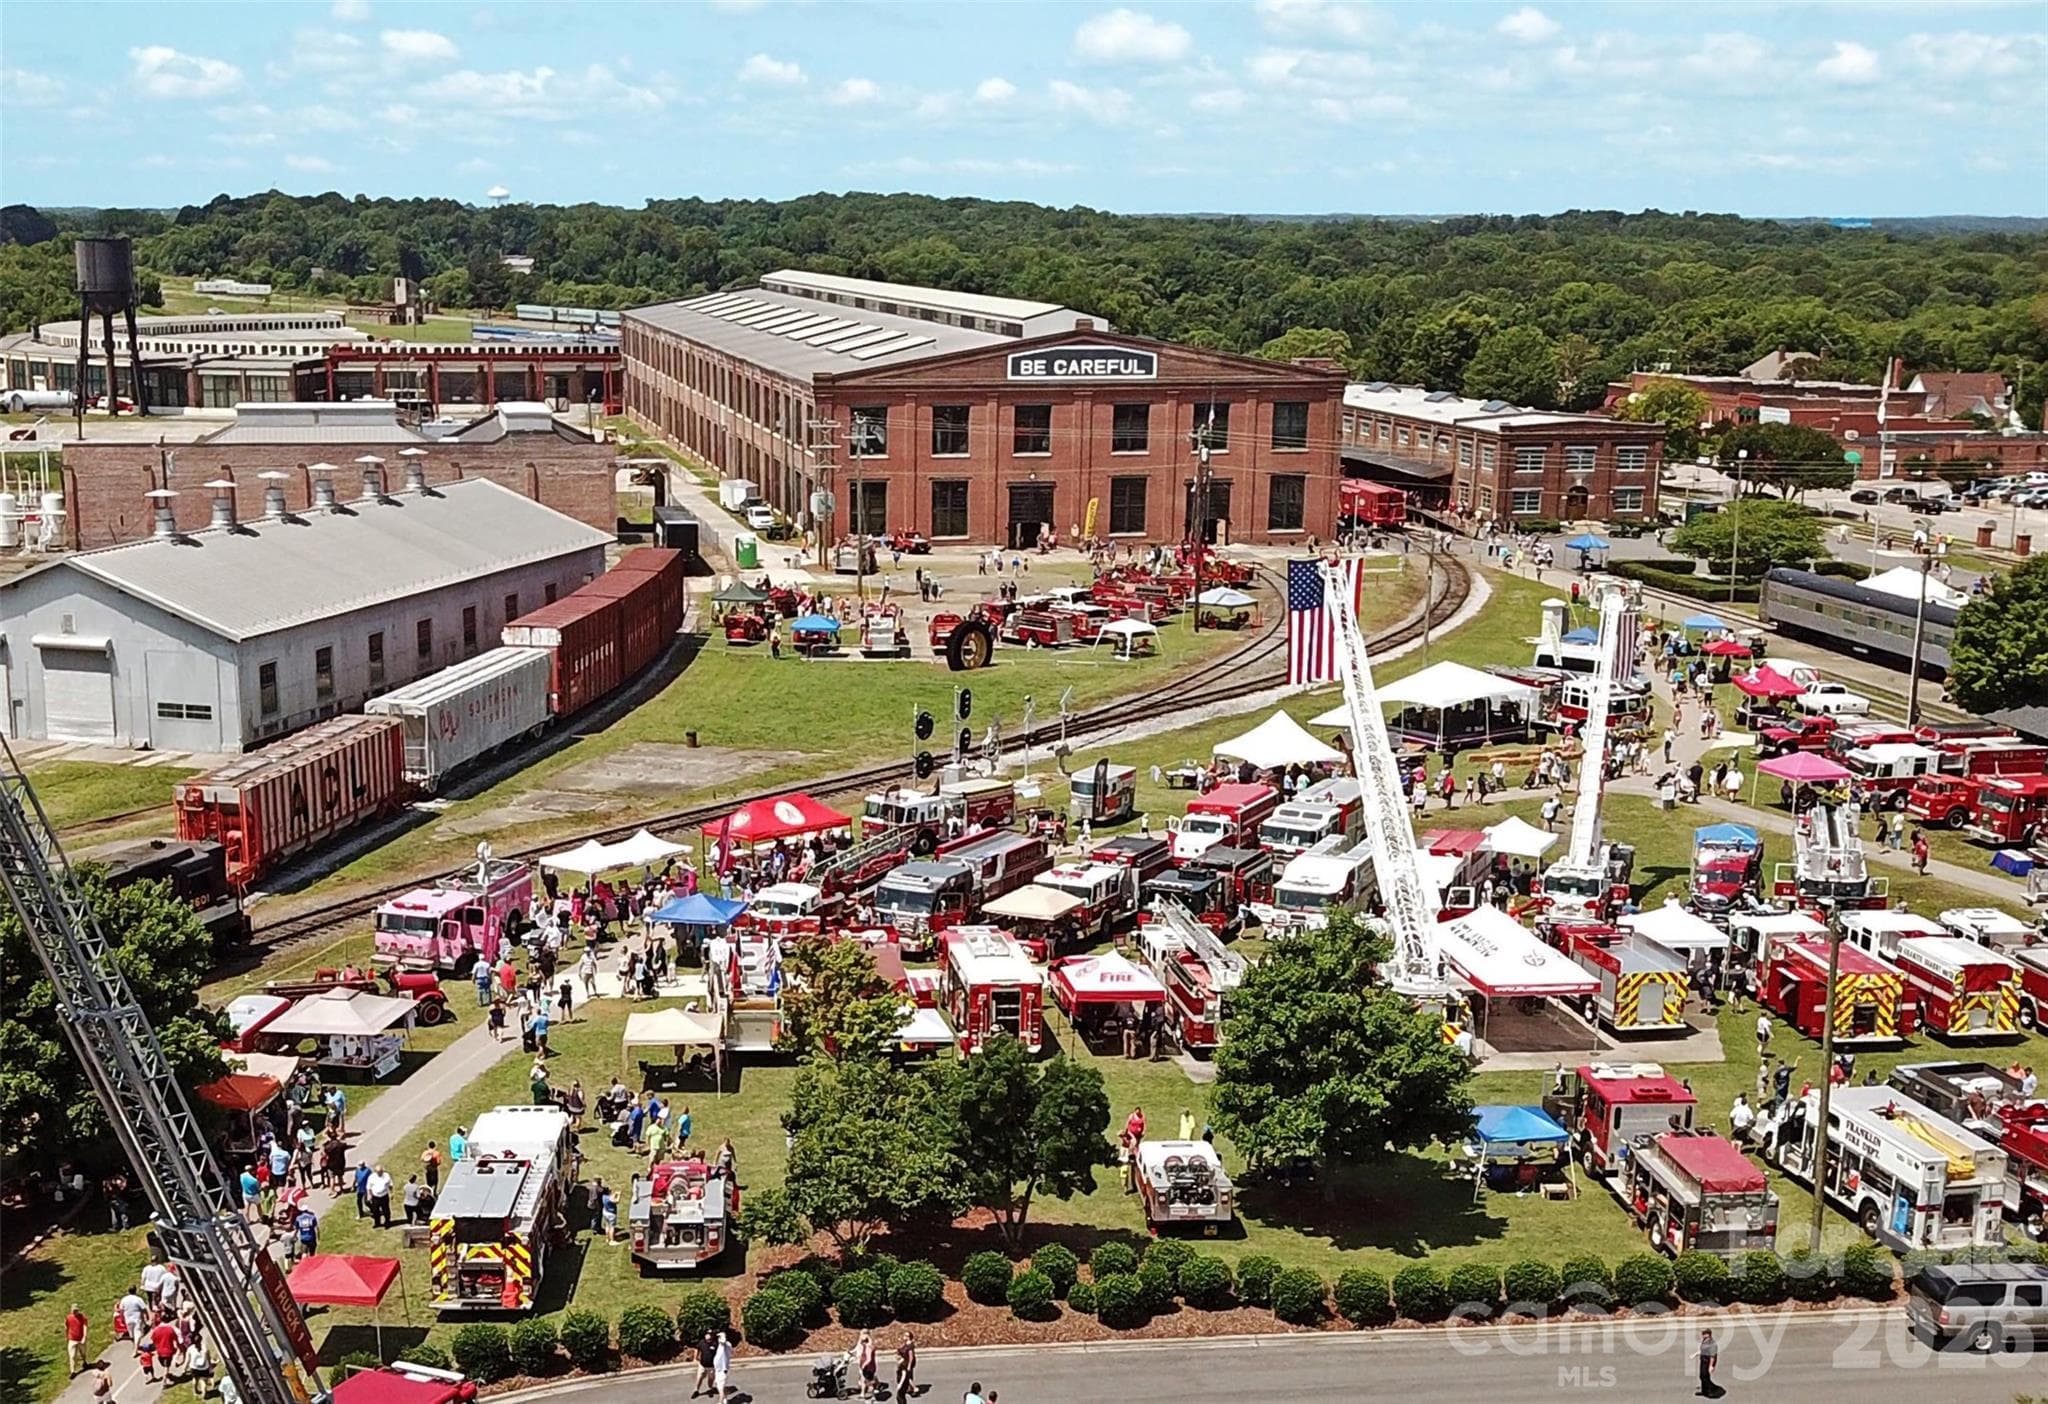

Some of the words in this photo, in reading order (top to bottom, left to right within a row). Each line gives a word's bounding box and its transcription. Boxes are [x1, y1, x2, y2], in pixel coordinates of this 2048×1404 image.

[1020, 359, 1047, 375] BE
[1053, 358, 1146, 375] CAREFUL
[290, 752, 367, 832] ACL
[1100, 971, 1135, 983] FIRE
[1844, 1131, 1860, 1147] FIRE
[1846, 1119, 1882, 1147] FRANKLIN
[274, 1280, 301, 1333] TRUCK
